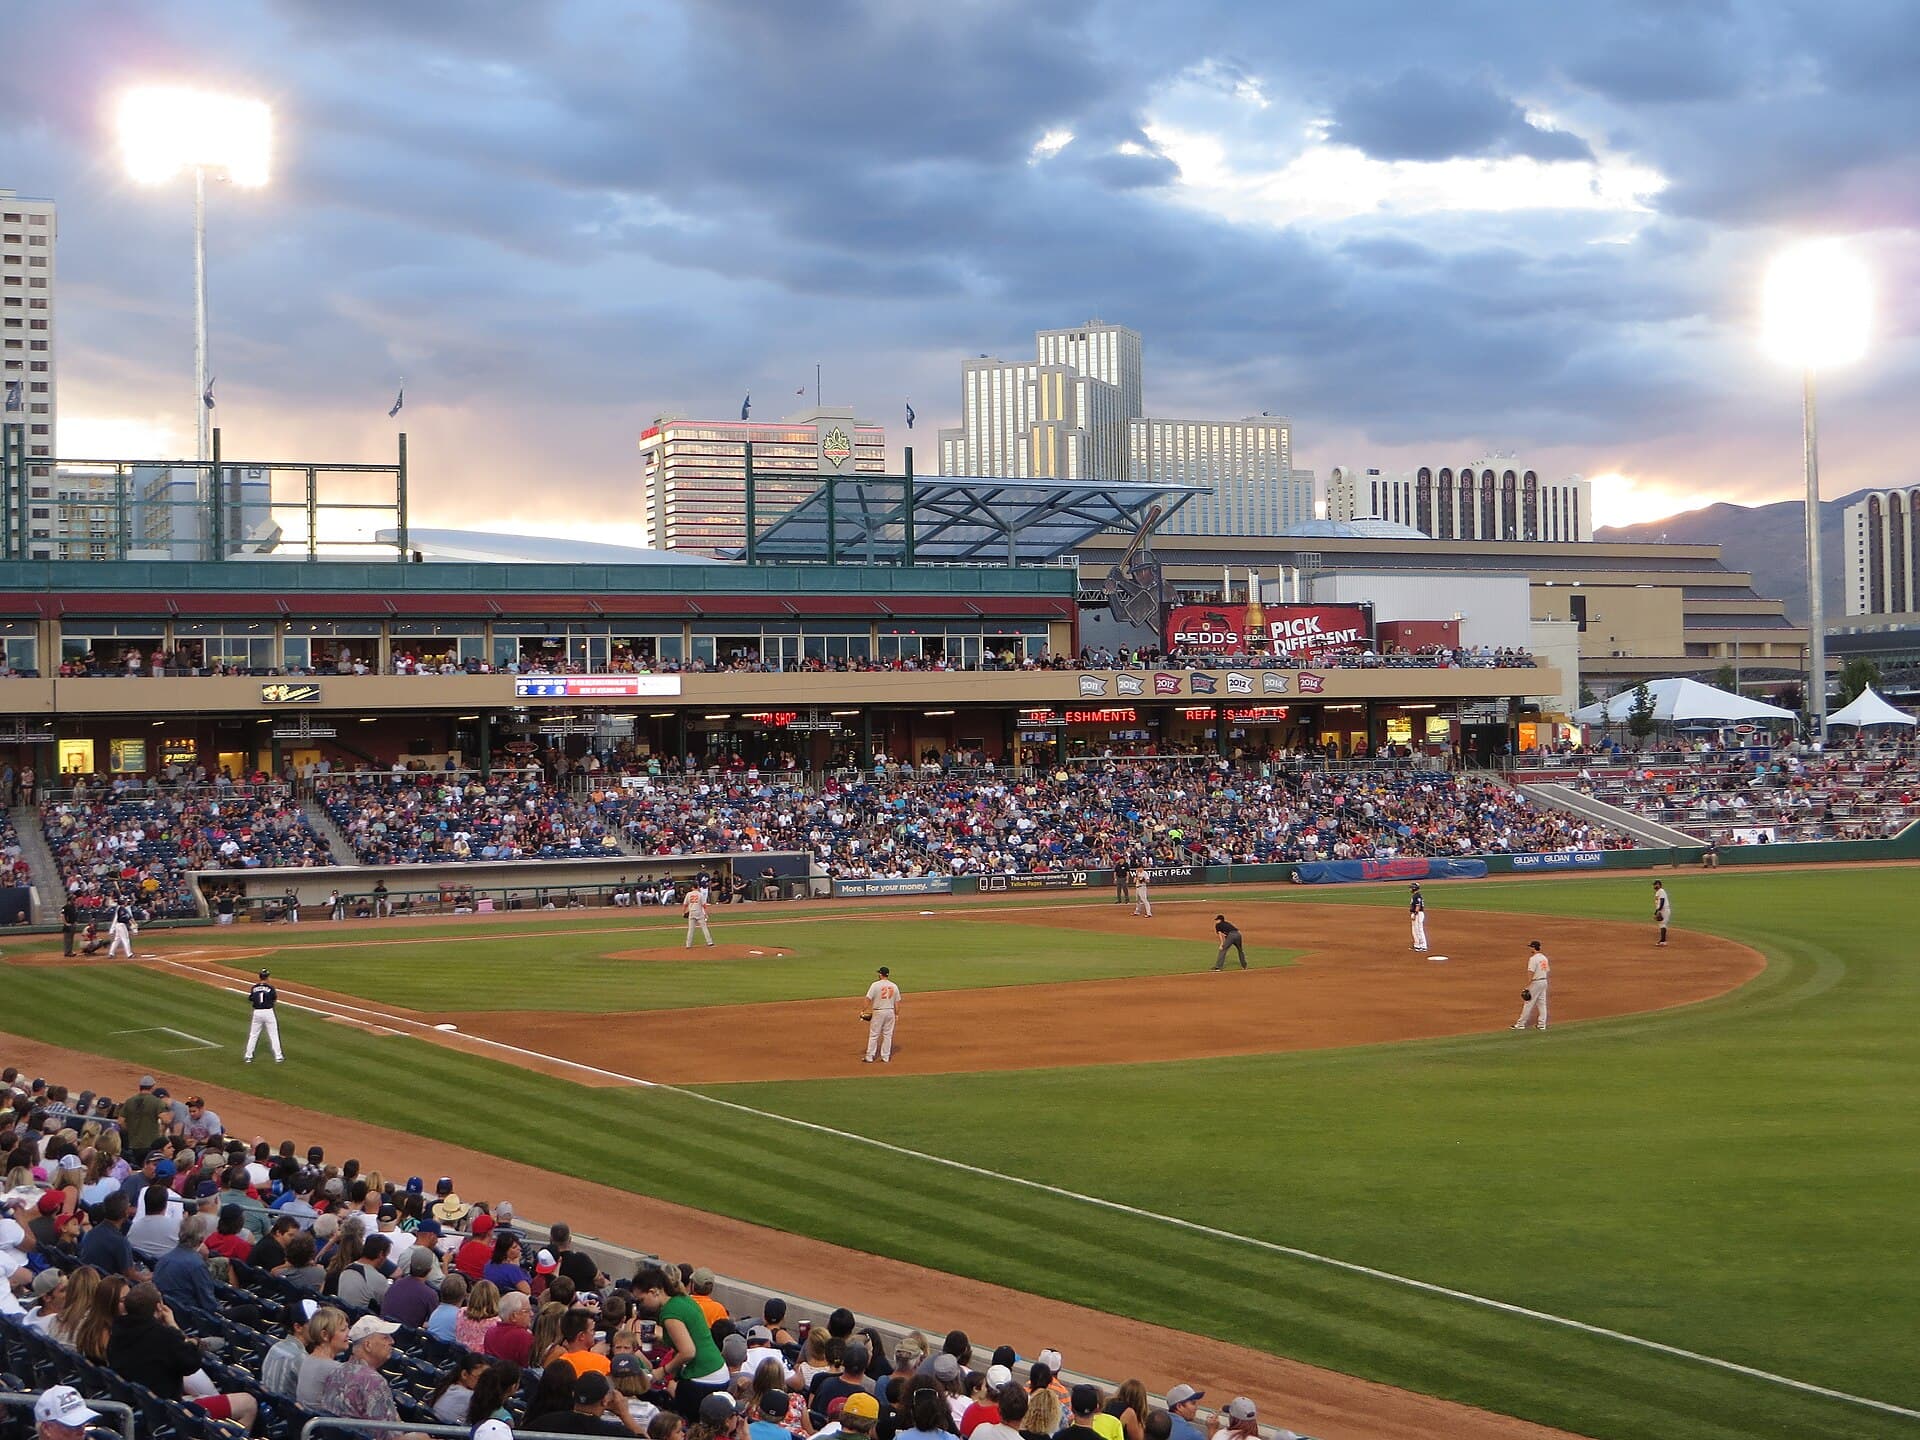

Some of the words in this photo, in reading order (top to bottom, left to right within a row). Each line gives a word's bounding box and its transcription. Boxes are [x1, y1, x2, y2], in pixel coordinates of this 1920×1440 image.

[1270, 616, 1321, 639] PICK
[1174, 632, 1238, 644] REDD'S
[1119, 680, 1137, 690] 2012
[1156, 680, 1175, 689] 2012
[1229, 679, 1246, 688] 2012
[1265, 679, 1282, 688] 2014
[1300, 679, 1318, 688] 2014
[518, 686, 528, 695] 2
[537, 686, 547, 695] 2
[1030, 710, 1137, 723] REESHMENTS
[1186, 708, 1287, 720] REFRSMETS
[1513, 856, 1539, 865] GILDAN
[1544, 854, 1570, 863] GILDAN
[1575, 853, 1600, 862] GILDAN
[1071, 872, 1087, 883] yp
[1130, 868, 1170, 878] WTNEY
[1171, 868, 1192, 876] PEAK
[842, 885, 864, 893] More.
[866, 884, 879, 892] For
[881, 884, 898, 893] your
[900, 883, 928, 892] money.
[260, 991, 264, 1003] 1
